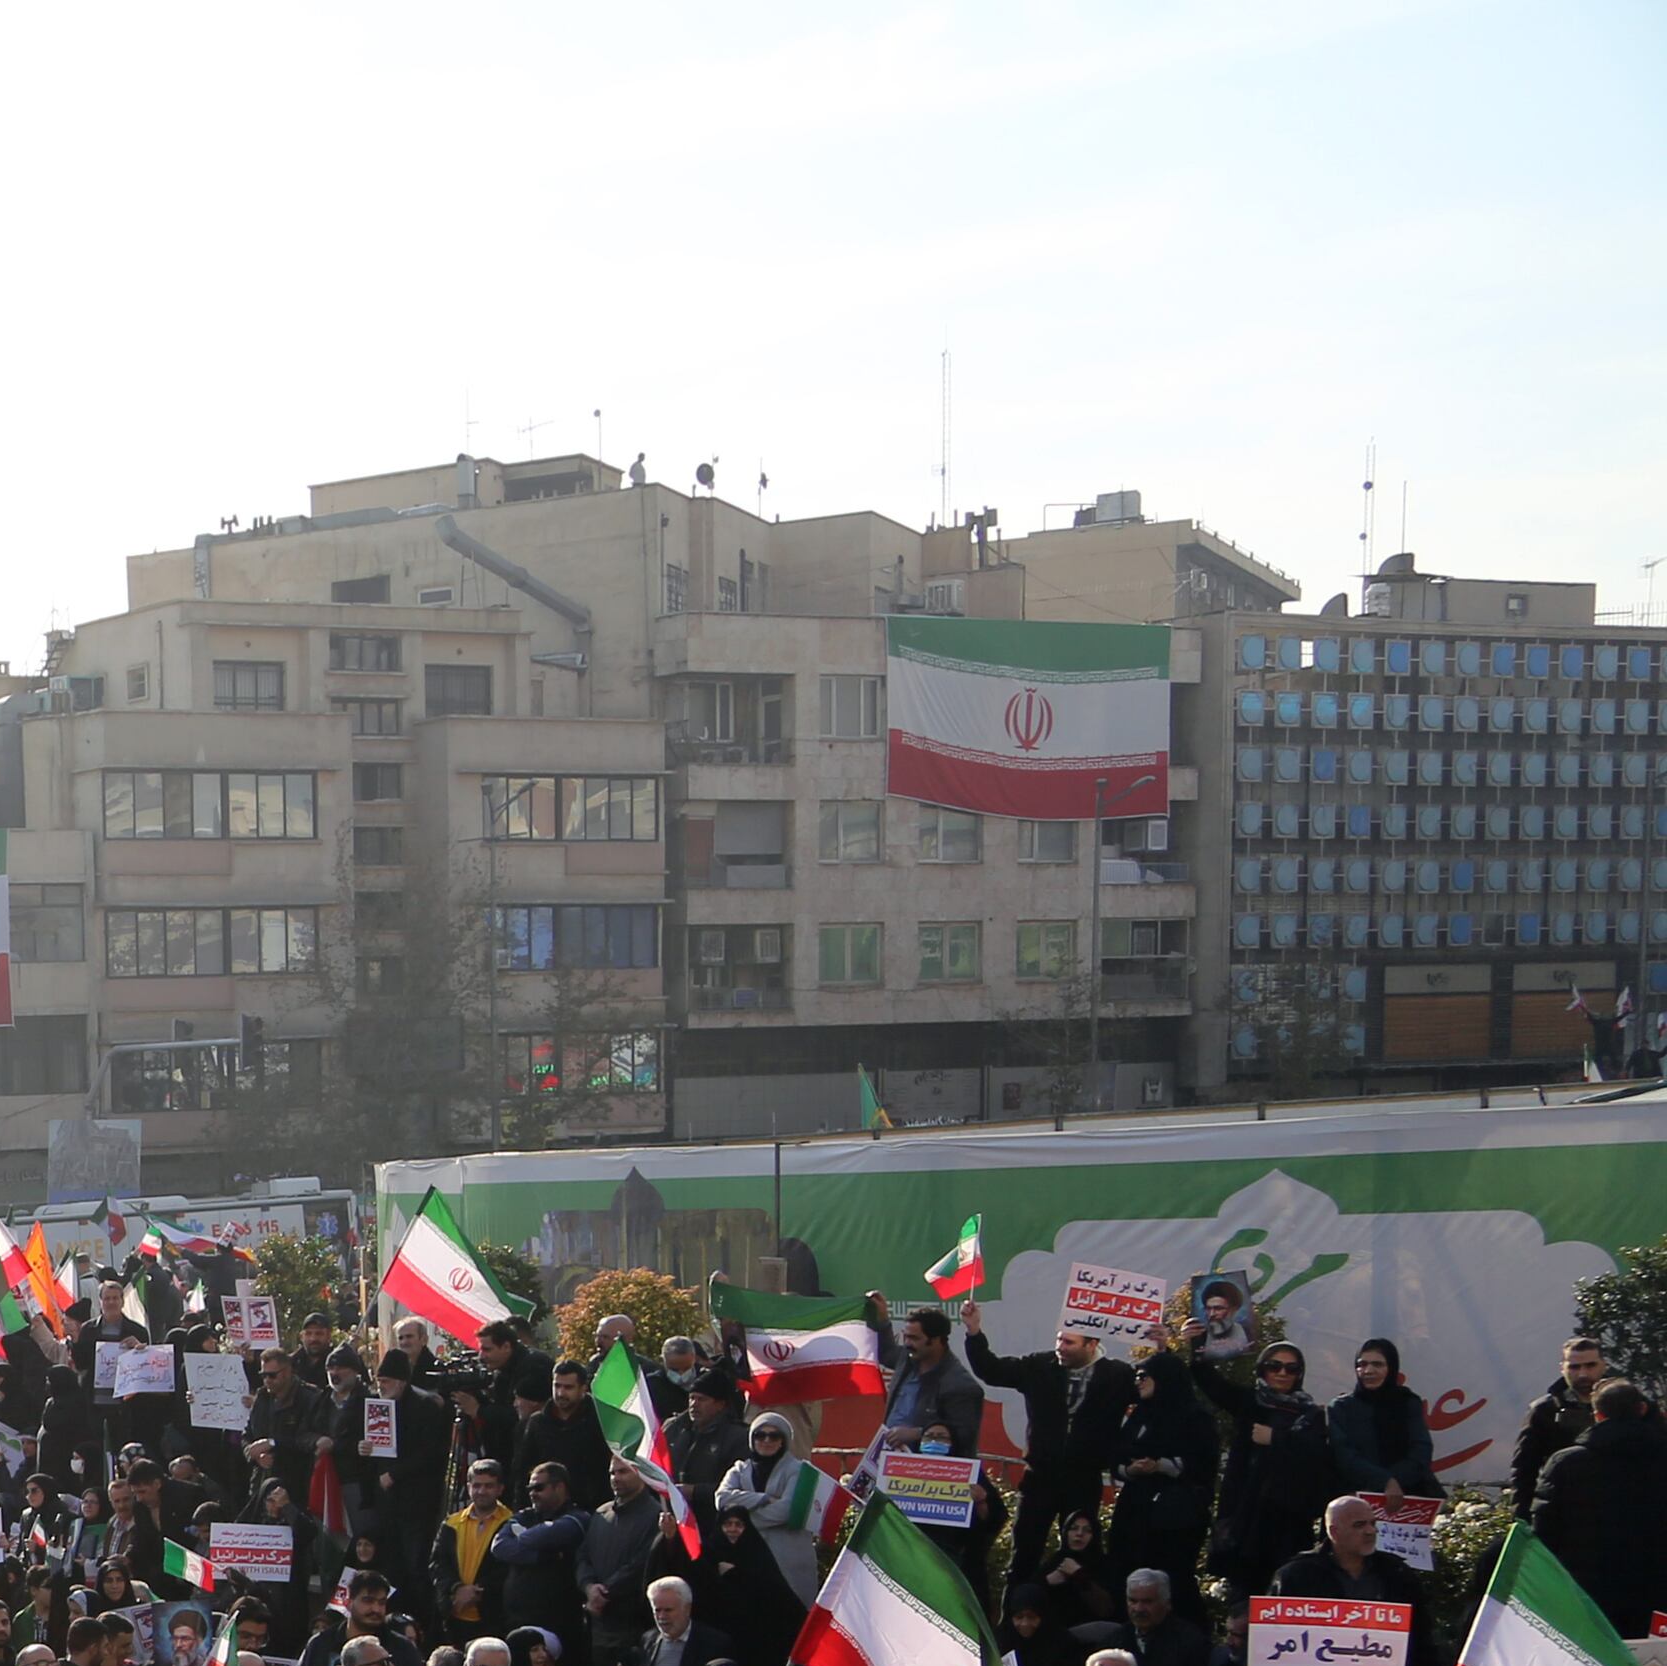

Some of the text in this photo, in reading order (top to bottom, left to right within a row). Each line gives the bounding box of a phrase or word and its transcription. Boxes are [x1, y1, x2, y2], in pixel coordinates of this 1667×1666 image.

[257, 1218, 280, 1235] 115
[1077, 1270, 1159, 1298] مرگ بر آمریکا
[1069, 1290, 1160, 1319] مرگ بر اسرائیل
[1064, 1315, 1149, 1340] رگ بر انگلیس
[925, 1486, 938, 1497] بر
[897, 1500, 966, 1516] WN WITH USA
[210, 1549, 291, 1563] مرگ بر اسرائیل
[261, 1566, 290, 1577] ISRAEL
[1258, 1602, 1403, 1624] ما تا آخر ایستاده ایم
[1267, 1629, 1393, 1662] مطیع امر
